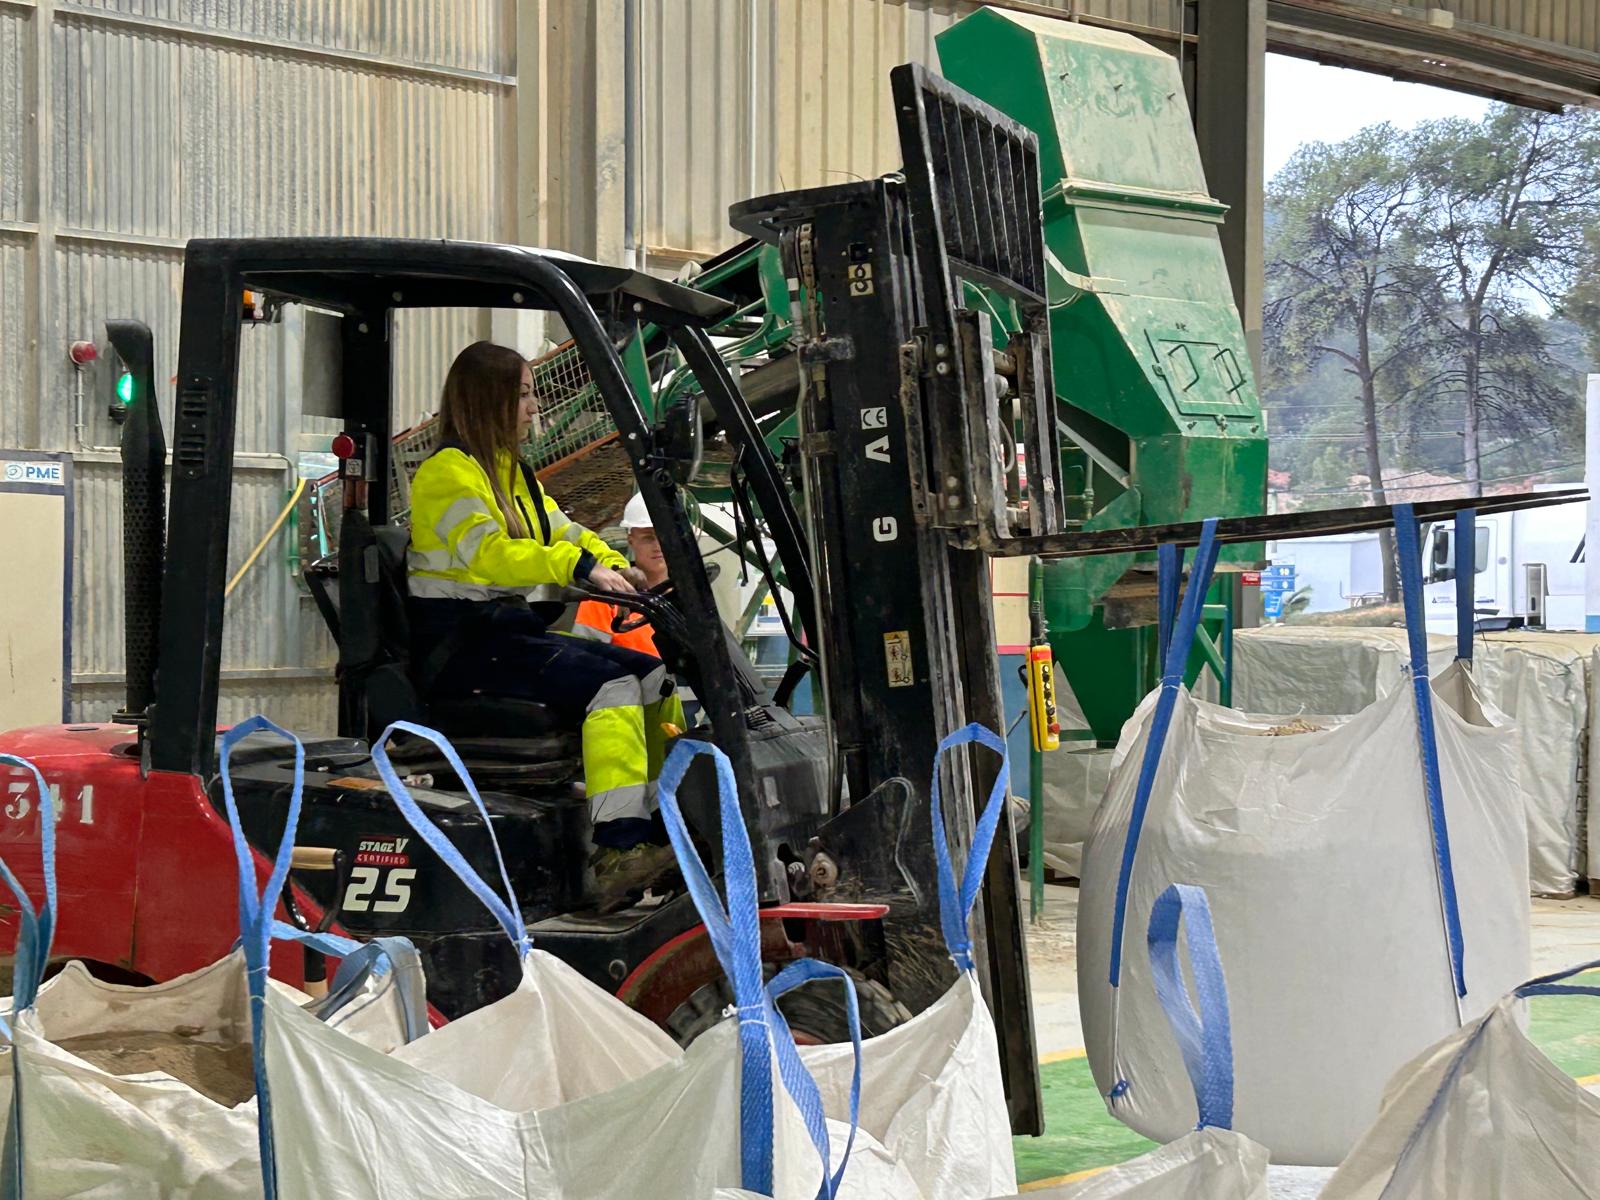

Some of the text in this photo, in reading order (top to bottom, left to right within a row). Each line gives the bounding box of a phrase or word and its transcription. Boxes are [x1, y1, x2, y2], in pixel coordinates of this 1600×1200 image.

[26, 466, 60, 479] PME
[359, 838, 409, 854] STAGE V
[342, 866, 417, 913] 25
